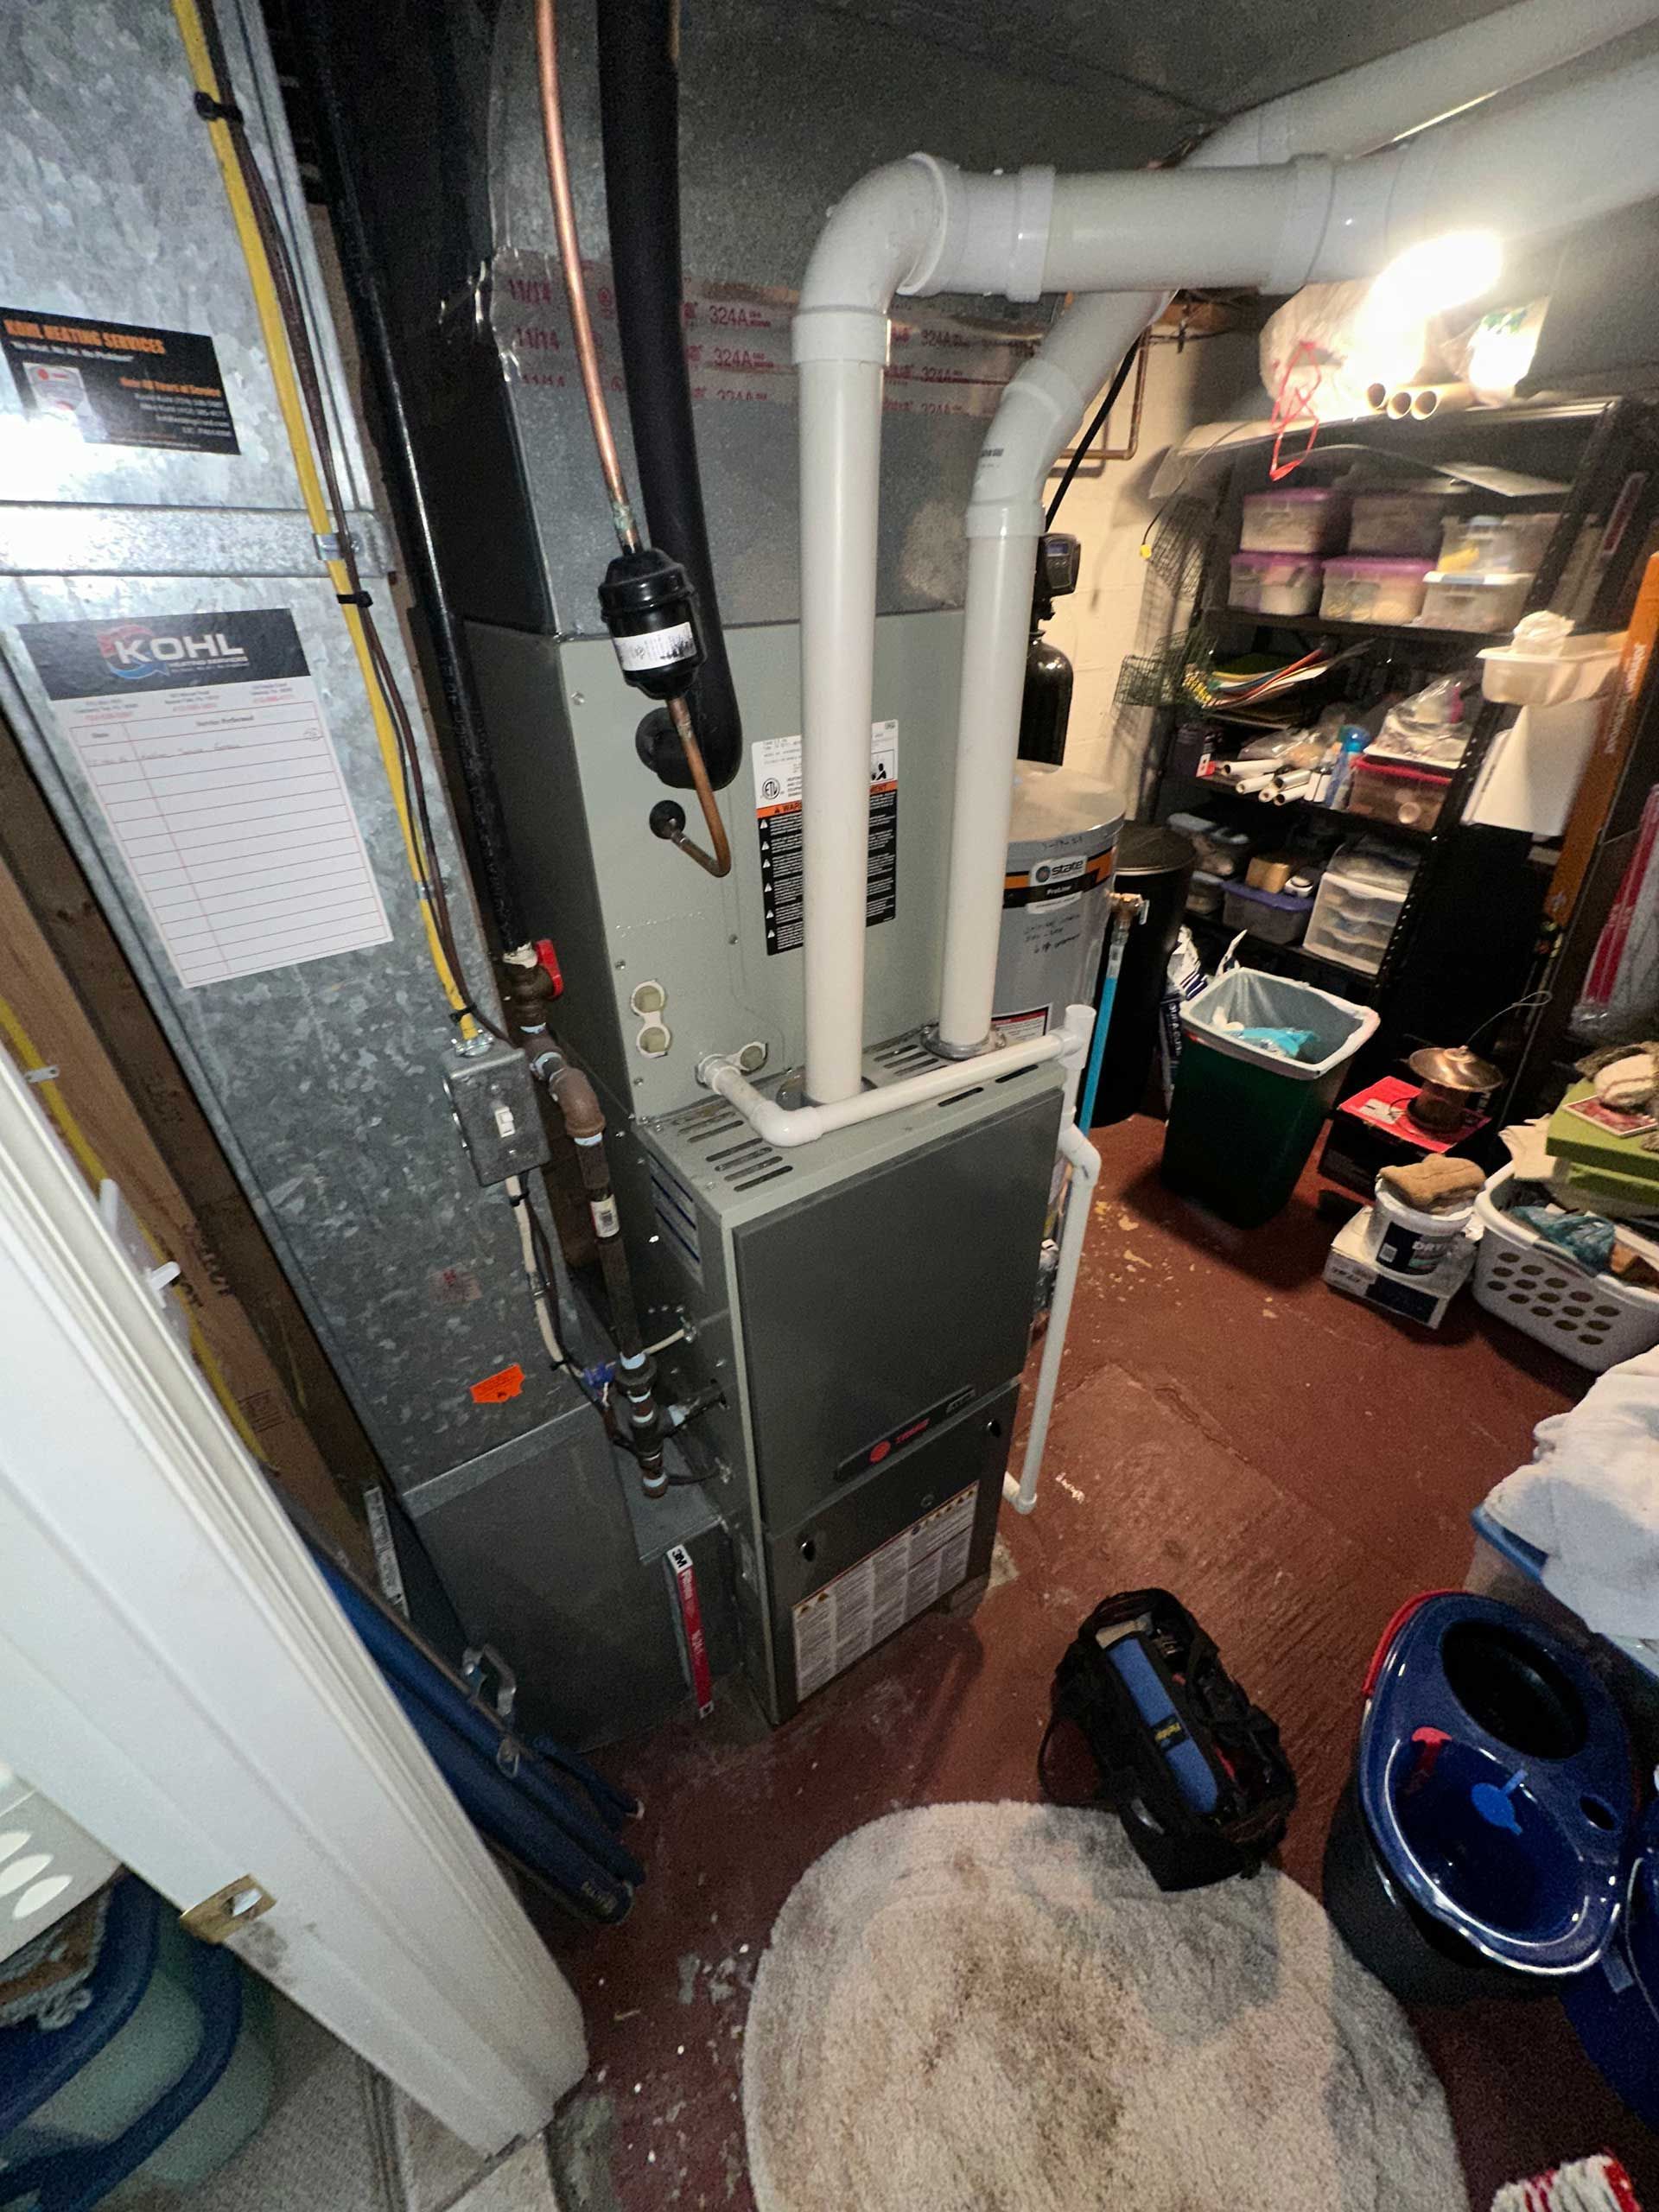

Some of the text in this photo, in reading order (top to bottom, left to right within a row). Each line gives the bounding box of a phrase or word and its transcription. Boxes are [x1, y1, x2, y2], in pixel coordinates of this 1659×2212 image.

[708, 305, 748, 326] 324A
[114, 633, 245, 664] KOHL
[672, 1548, 687, 1567] 3M
